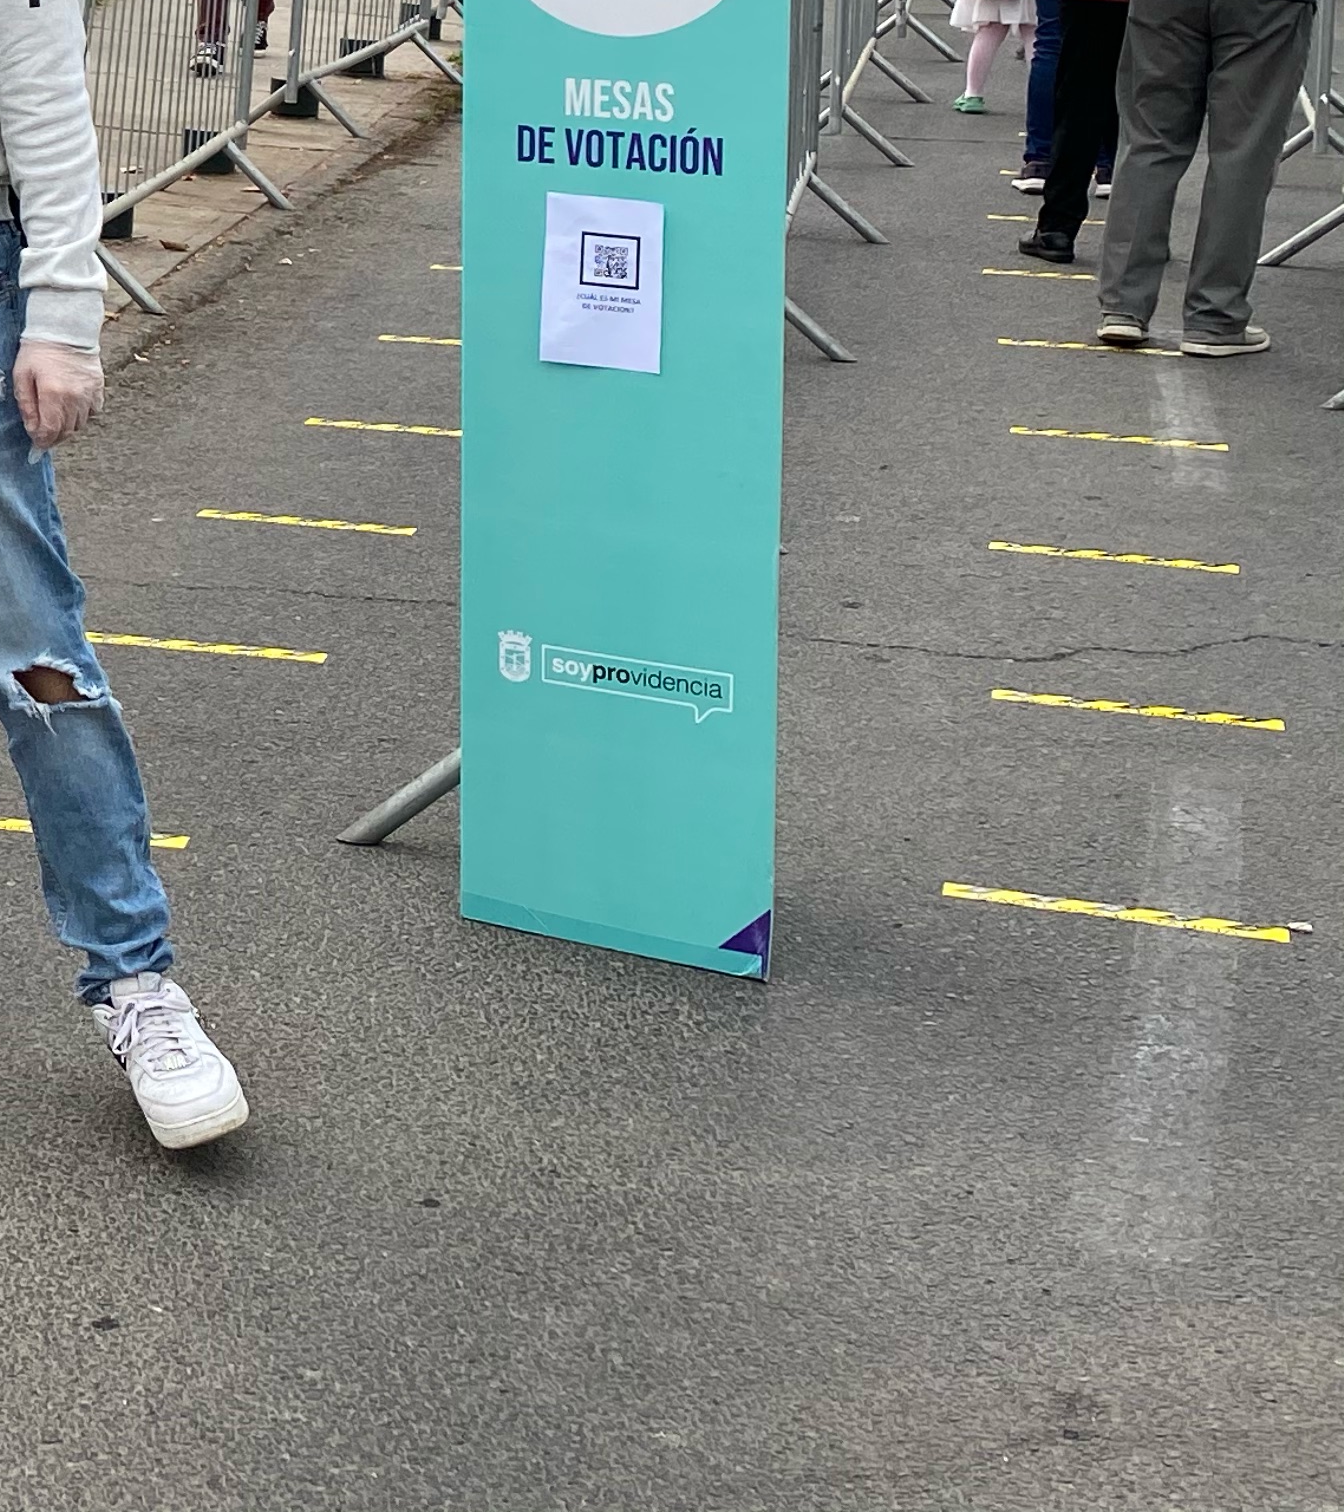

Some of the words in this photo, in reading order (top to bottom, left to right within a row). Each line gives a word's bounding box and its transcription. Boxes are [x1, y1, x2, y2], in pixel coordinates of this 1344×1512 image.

[565, 78, 674, 122] MESAS
[517, 125, 555, 164] DE
[565, 127, 723, 176] VOTACIÓN
